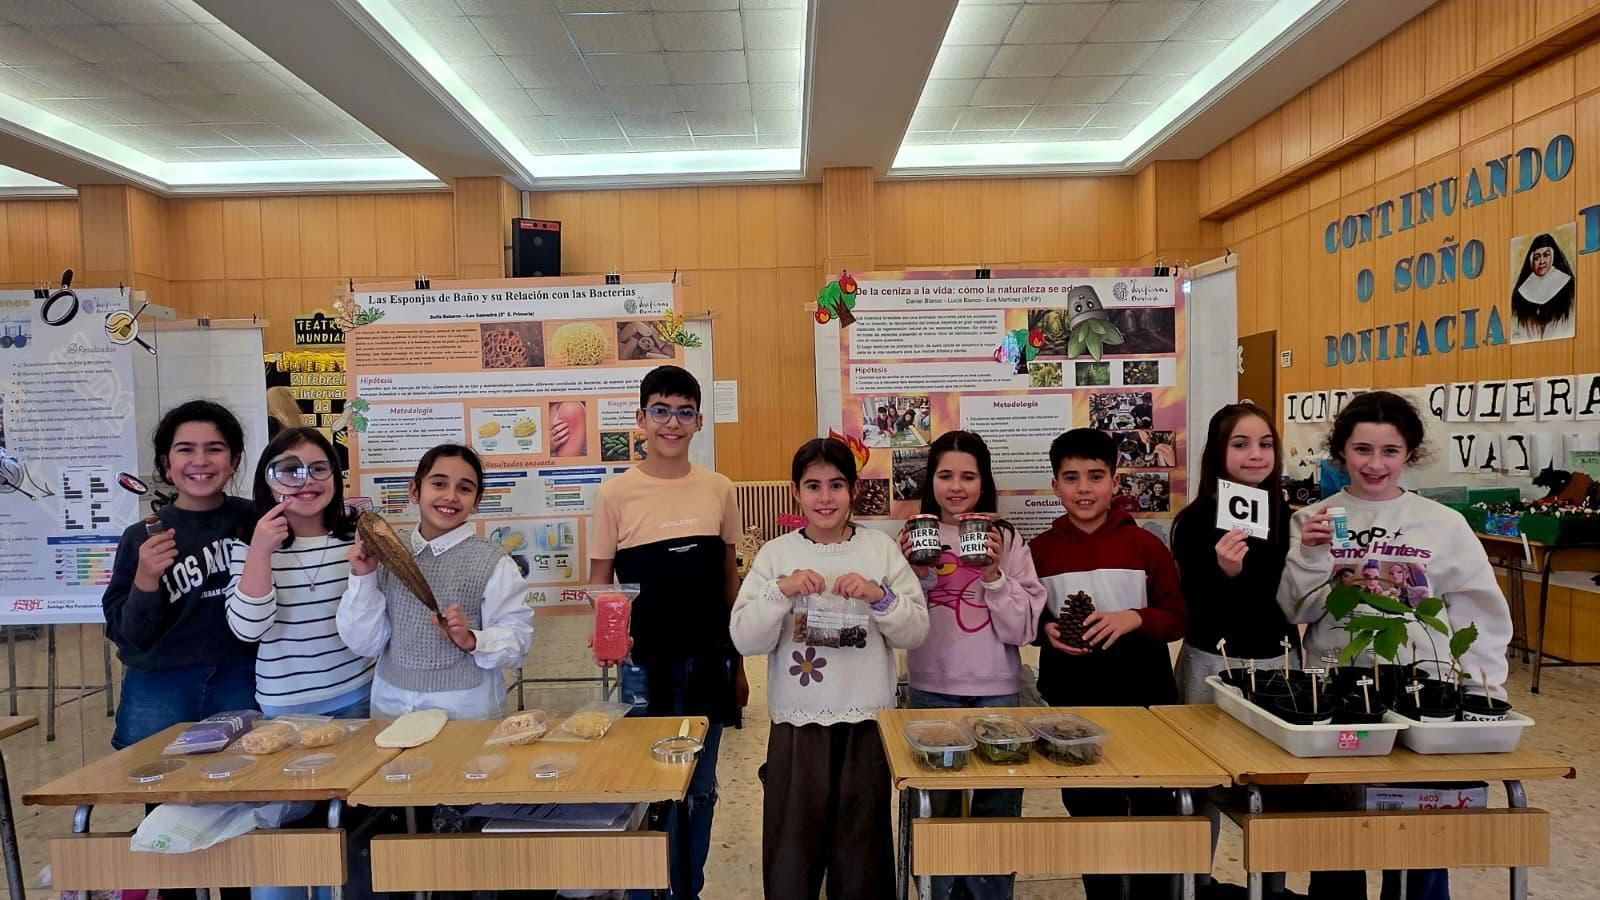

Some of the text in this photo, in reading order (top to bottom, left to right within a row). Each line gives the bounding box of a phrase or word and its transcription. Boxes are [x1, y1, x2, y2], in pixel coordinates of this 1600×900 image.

[1324, 134, 1575, 254] CONTINUANDO
[1357, 235, 1485, 304] O SOÑO
[368, 287, 636, 306] Las Esponjas de Baño y su Relación con las Bacterias
[870, 287, 879, 296] la
[881, 287, 912, 296] ceniza
[922, 286, 930, 295] la
[933, 286, 956, 295] vida:
[958, 285, 984, 294] cómo
[986, 285, 995, 294] la
[997, 284, 1046, 294] naturaleza
[1061, 284, 1074, 293] ad
[1324, 304, 1508, 368] BONIFACIA
[855, 367, 888, 375] Hipótesis
[389, 407, 433, 415] Metodología
[993, 400, 1039, 409] Metodología
[1024, 498, 1061, 507] Conclusi
[162, 554, 204, 604] LOS
